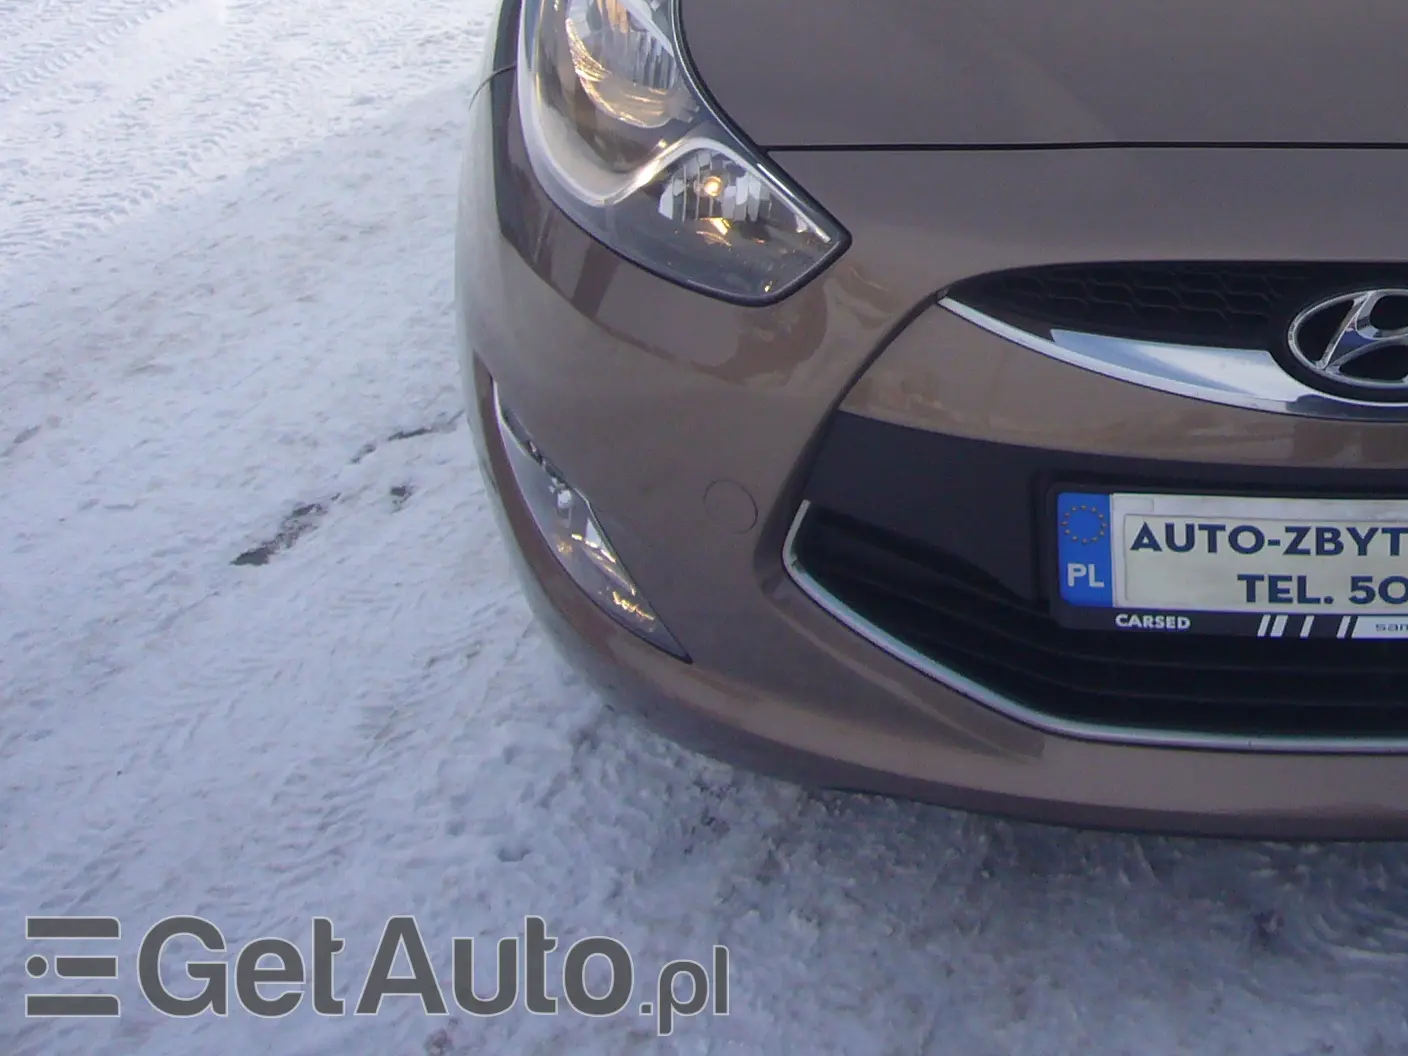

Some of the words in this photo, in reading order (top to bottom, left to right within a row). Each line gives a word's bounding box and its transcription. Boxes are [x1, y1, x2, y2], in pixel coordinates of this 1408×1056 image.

[1067, 563, 1104, 588] PL
[1237, 574, 1334, 605] TEL.
[1115, 613, 1190, 630] CARSED
